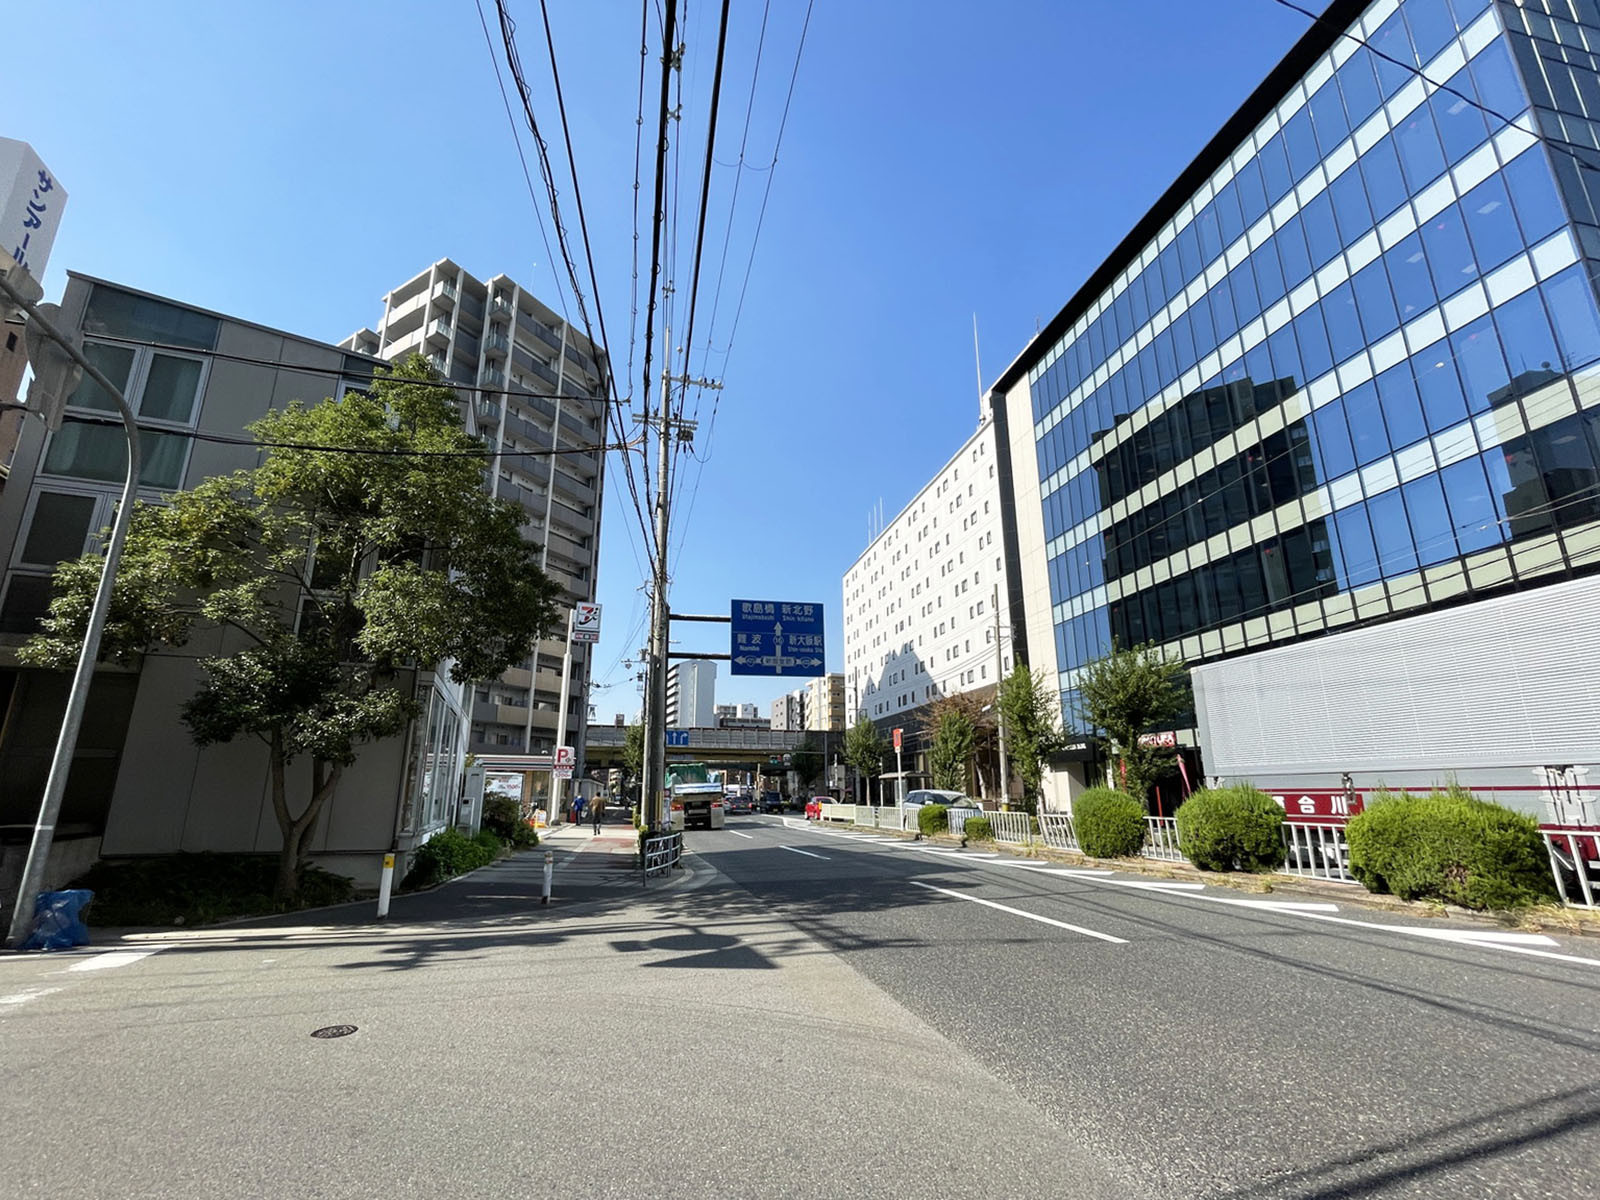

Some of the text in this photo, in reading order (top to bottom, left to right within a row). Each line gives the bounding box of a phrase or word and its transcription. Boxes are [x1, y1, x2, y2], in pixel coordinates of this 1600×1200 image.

[782, 604, 814, 615] 新北野
[789, 635, 823, 646] 新大阪駅
[557, 748, 569, 763] P
